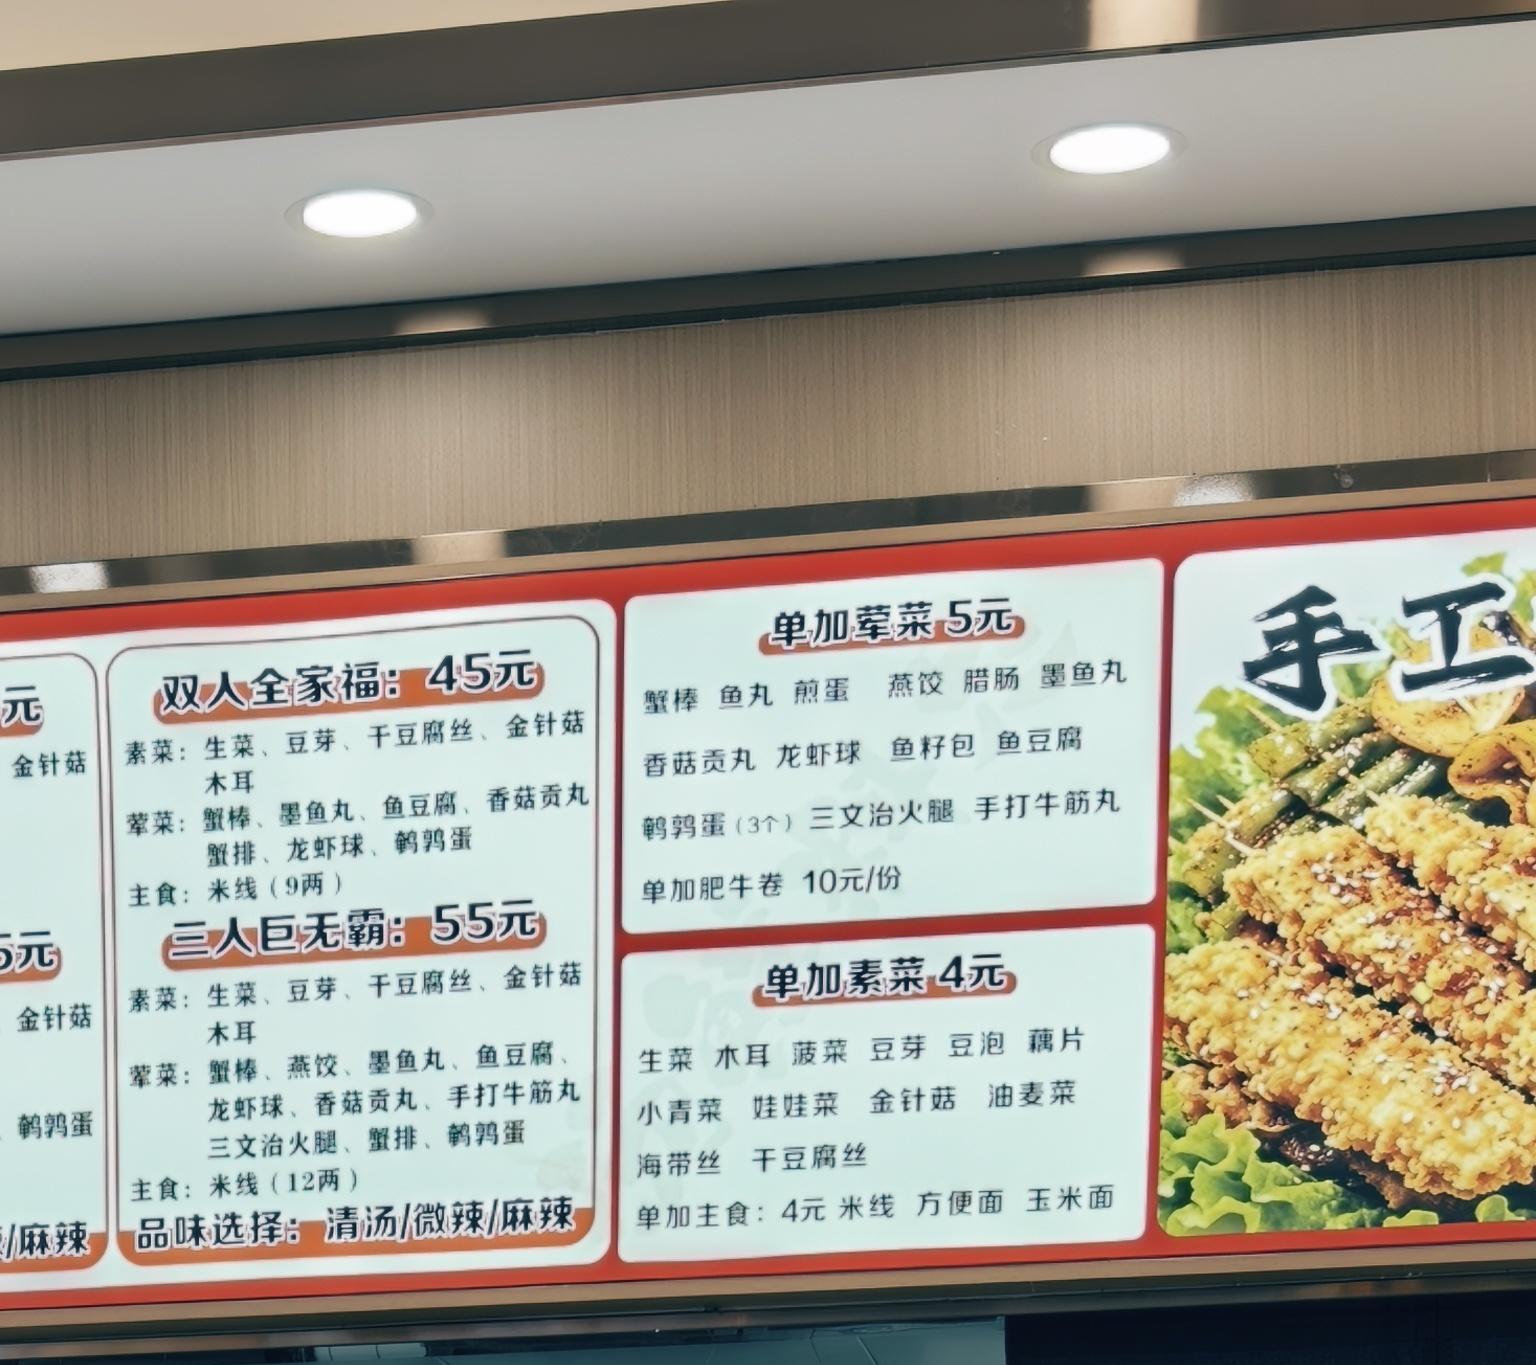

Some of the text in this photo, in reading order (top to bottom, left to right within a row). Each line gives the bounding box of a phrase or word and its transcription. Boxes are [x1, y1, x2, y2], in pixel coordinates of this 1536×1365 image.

[772, 603, 933, 647] 单加荤菜
[1243, 582, 1535, 711] 手工
[644, 659, 1127, 715] 蟹棒 鱼丸 煎蛋 燕饺 腊肠 墨鱼丸
[644, 726, 1082, 778] 香菇贡丸 龙虾球 鱼籽包 鱼豆腐
[205, 770, 254, 796] 木耳
[809, 798, 955, 831] 三文治火腿
[975, 788, 1121, 822] 手打牛筋丸
[642, 864, 902, 905] 单加肥牛卷 10元/份
[766, 955, 926, 1000] 单加素菜
[207, 1020, 256, 1046] 木耳
[638, 1026, 1084, 1073] 生菜 木耳 菠菜 豆芽 豆泡 藕片
[637, 1080, 1076, 1126] 小青菜 娃娃菜 金针菇 油麦菜
[637, 1142, 868, 1178] 海带丝 干豆腐丝
[840, 1193, 895, 1221] 米线
[917, 1189, 1003, 1217] 方便面
[1027, 1184, 1114, 1212] 玉米面
